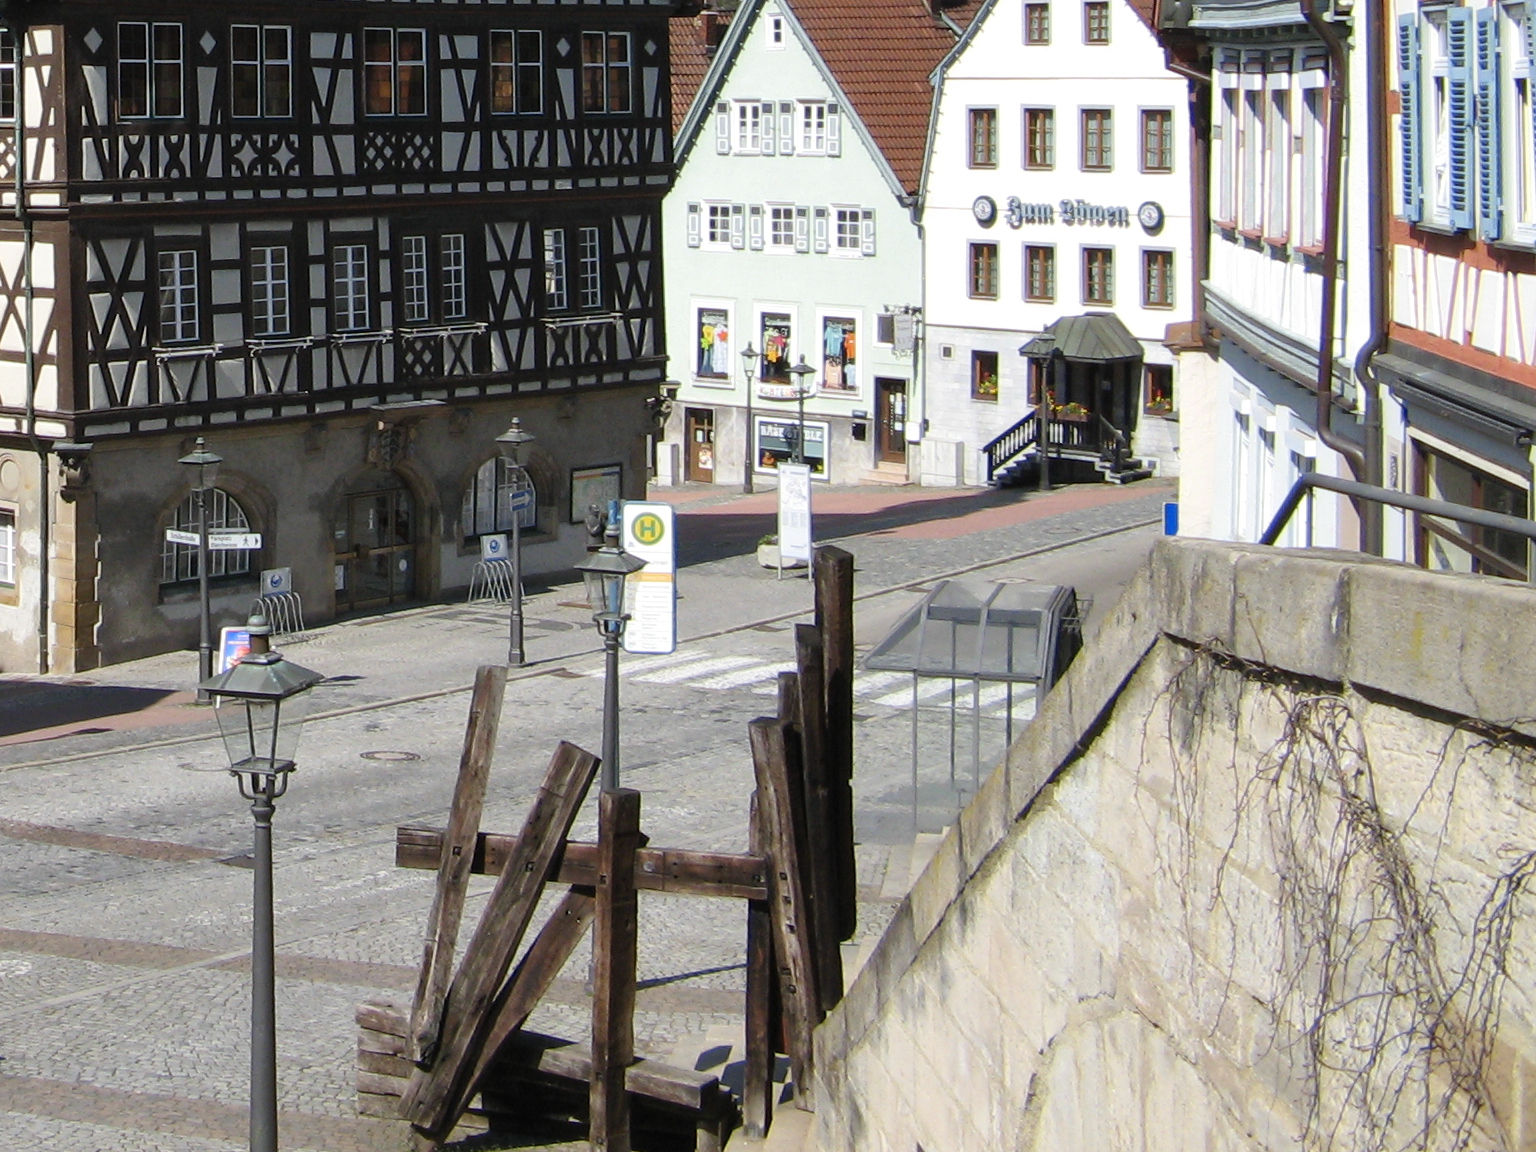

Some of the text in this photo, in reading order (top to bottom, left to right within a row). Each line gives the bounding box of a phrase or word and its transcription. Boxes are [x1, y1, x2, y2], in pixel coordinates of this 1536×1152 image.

[1004, 195, 1130, 228] Zum Löwen
[639, 519, 656, 538] H
